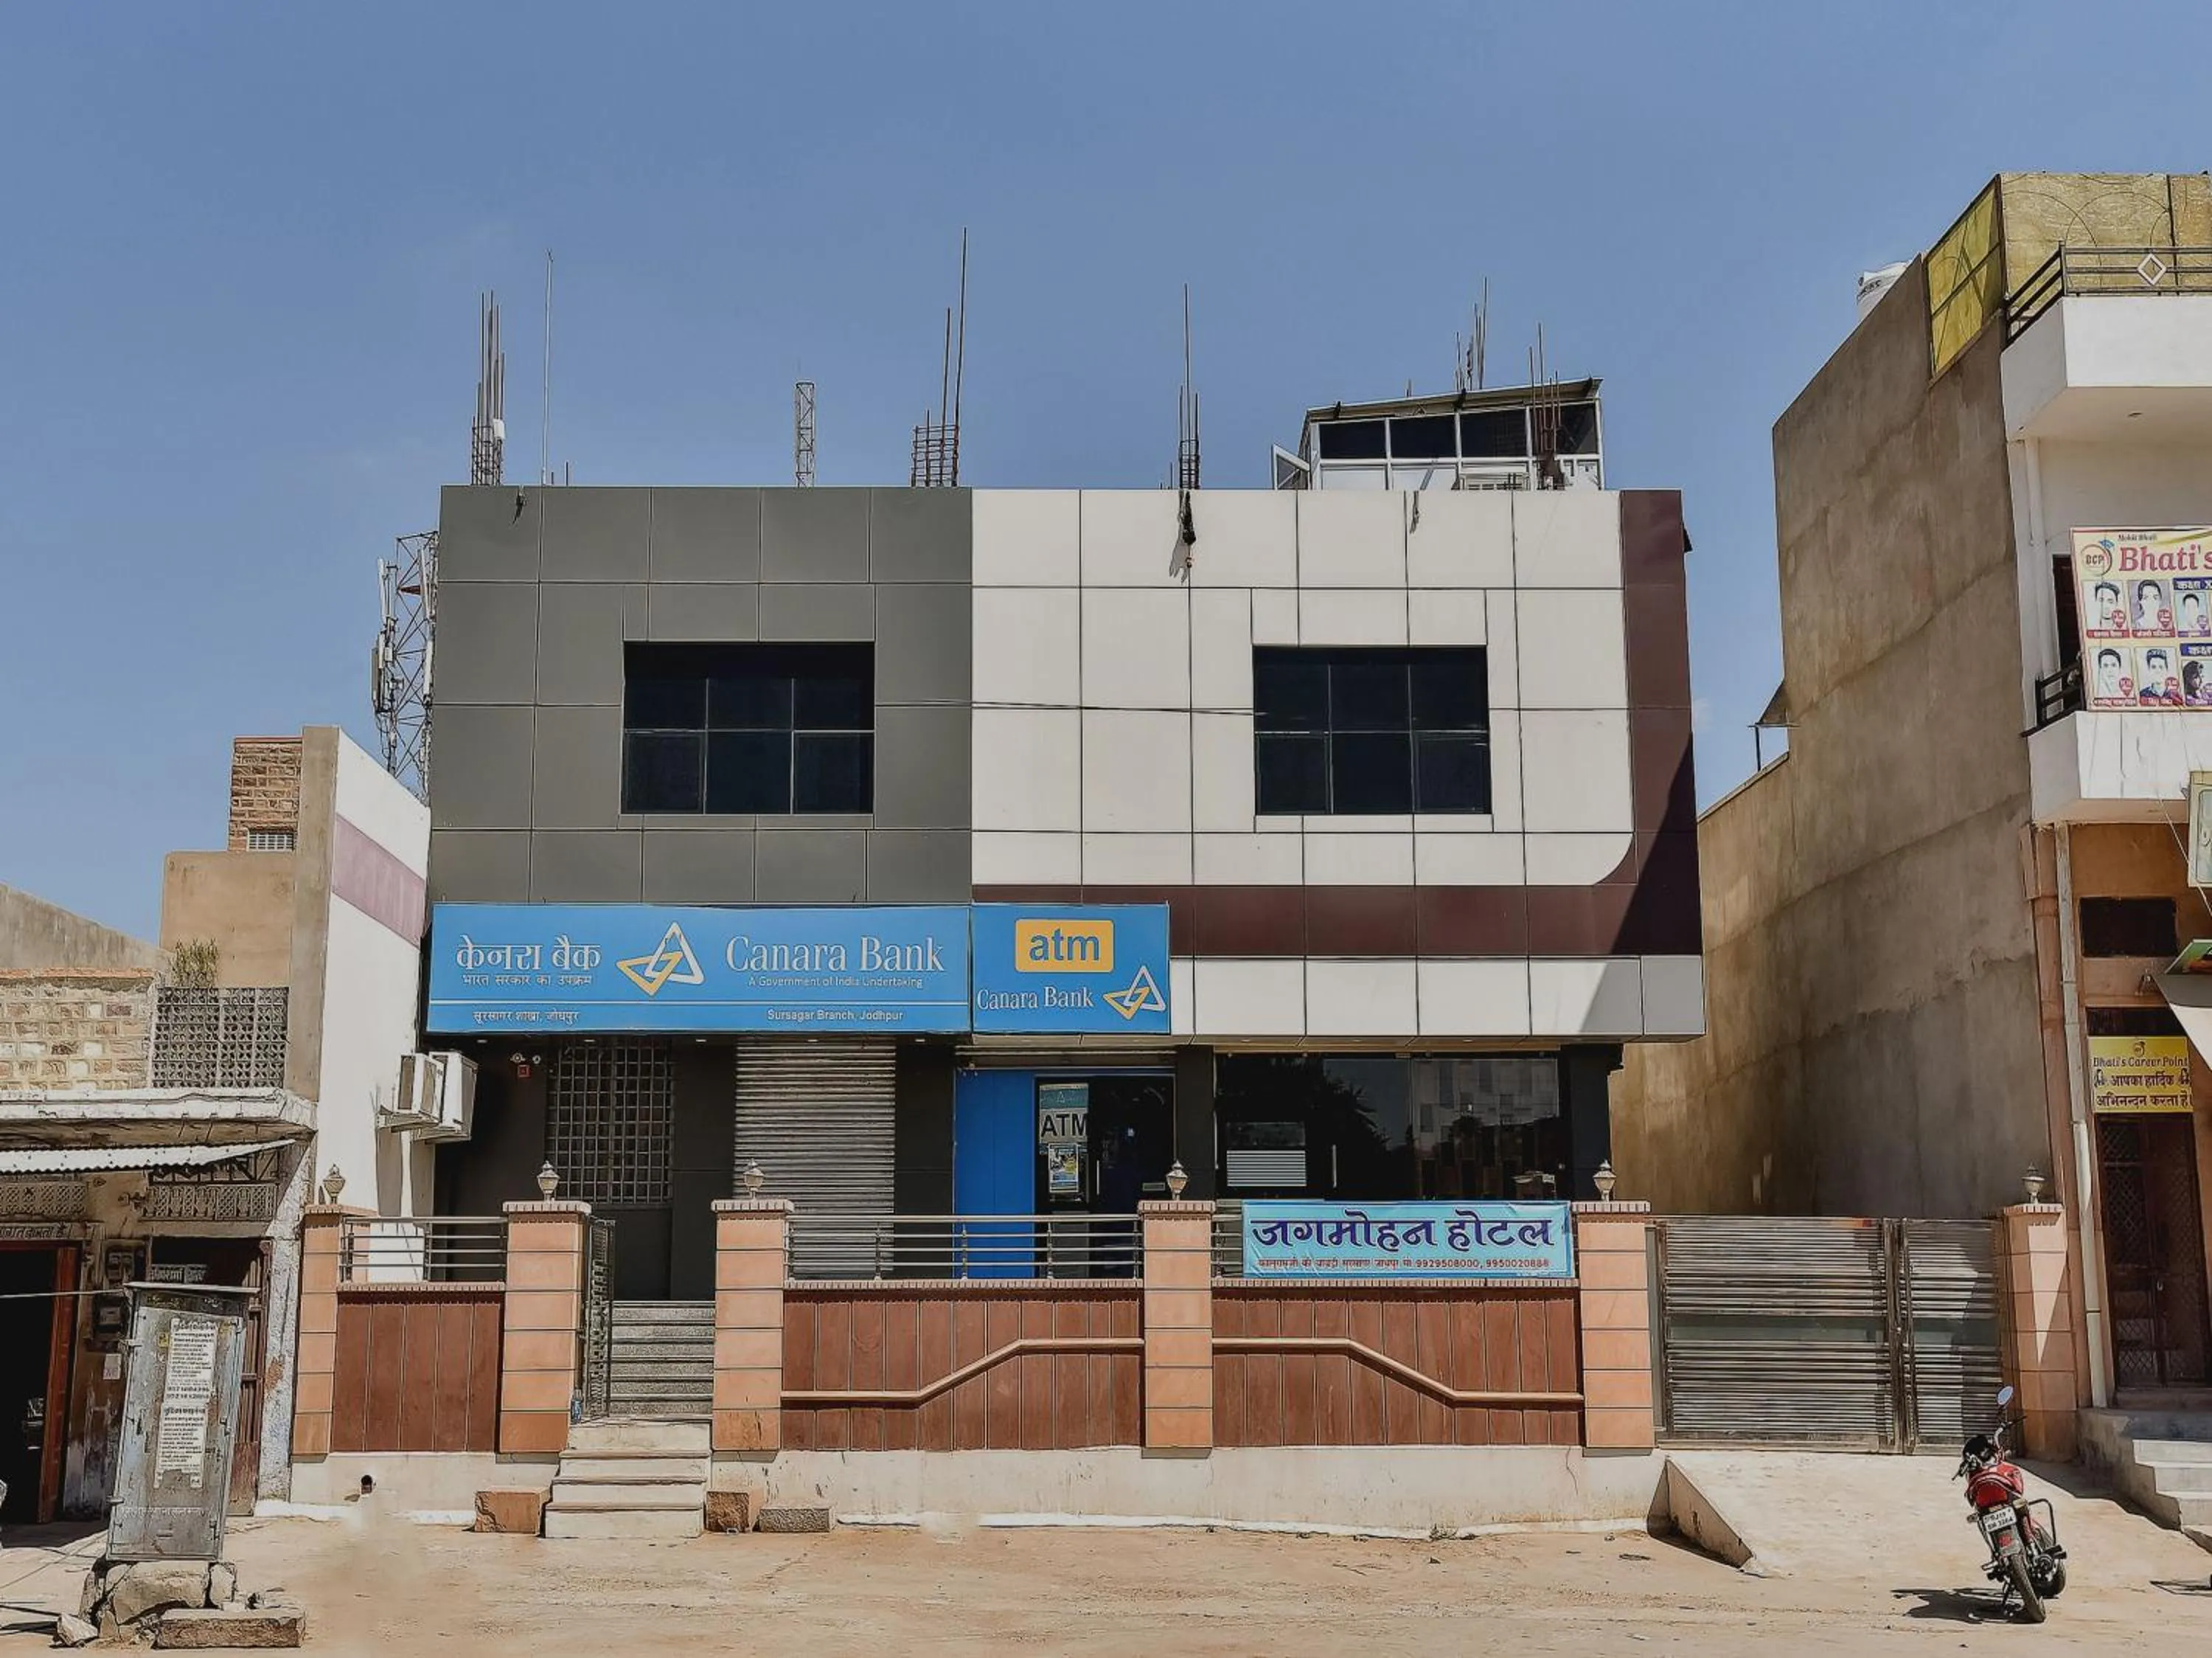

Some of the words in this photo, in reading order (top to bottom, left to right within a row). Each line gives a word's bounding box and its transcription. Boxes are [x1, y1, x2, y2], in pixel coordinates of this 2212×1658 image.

[2119, 544, 2212, 572] Bhati's
[726, 936, 847, 971] Canara
[858, 937, 945, 971] Bank
[1029, 928, 1099, 961] atm
[462, 974, 489, 986] भारत
[495, 974, 530, 986] सरकार
[536, 974, 551, 985] का
[557, 974, 592, 986] उपक्रम
[748, 977, 756, 986] A
[759, 977, 820, 986] Government
[822, 977, 833, 986] of
[835, 977, 860, 986] India
[863, 977, 923, 988] Undertaking
[977, 989, 1039, 1010] Canara
[1044, 986, 1094, 1007] Bank
[767, 1009, 815, 1022] Sursagar
[860, 1009, 904, 1022] Jodhpur
[2128, 1057, 2161, 1067] Career
[2163, 1056, 2188, 1067] Point
[2111, 1075, 2143, 1086] आपका
[2149, 1095, 2177, 1106] करता
[1041, 1113, 1088, 1137] ATM
[1251, 1210, 1437, 1252] जगमोहन
[1444, 1210, 1555, 1252] होटल
